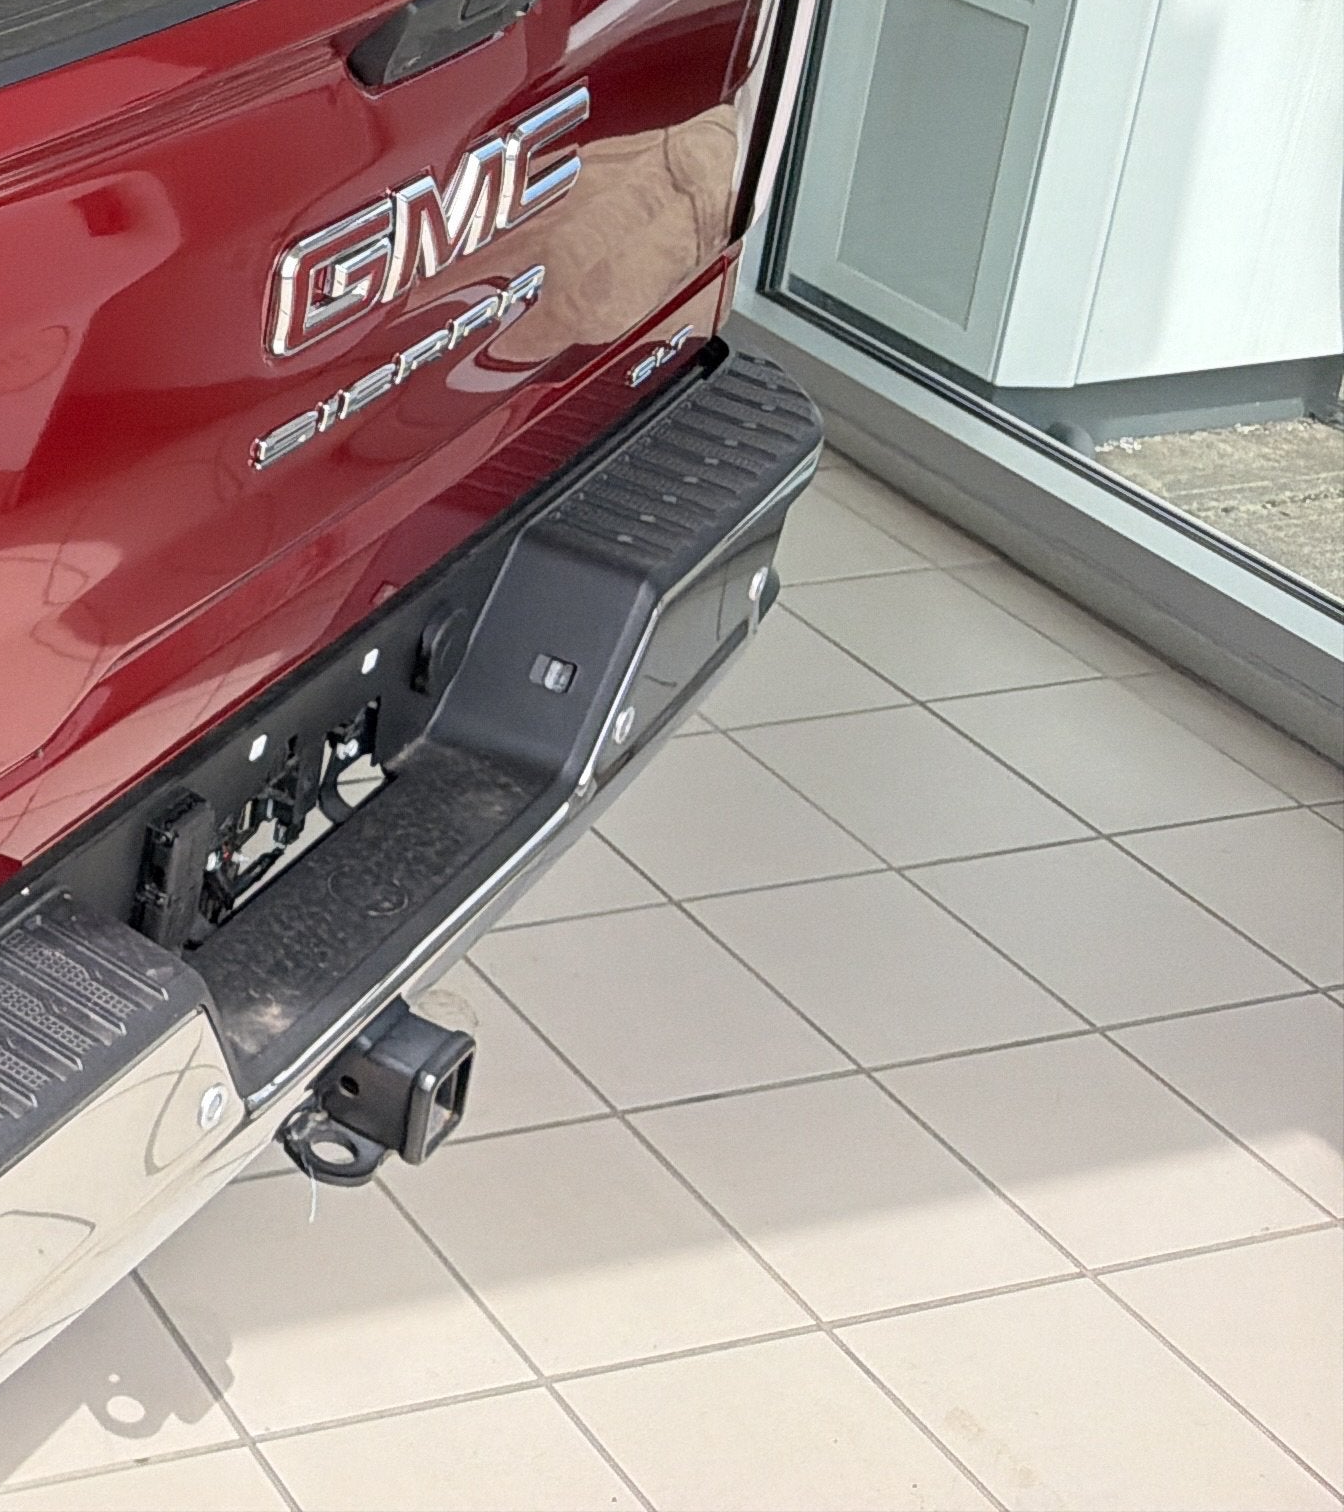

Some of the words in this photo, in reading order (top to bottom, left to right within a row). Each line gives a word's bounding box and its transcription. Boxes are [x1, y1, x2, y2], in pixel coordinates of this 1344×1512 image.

[262, 76, 590, 364] GMC
[249, 265, 546, 471] SIERRA
[626, 323, 695, 388] SLT
